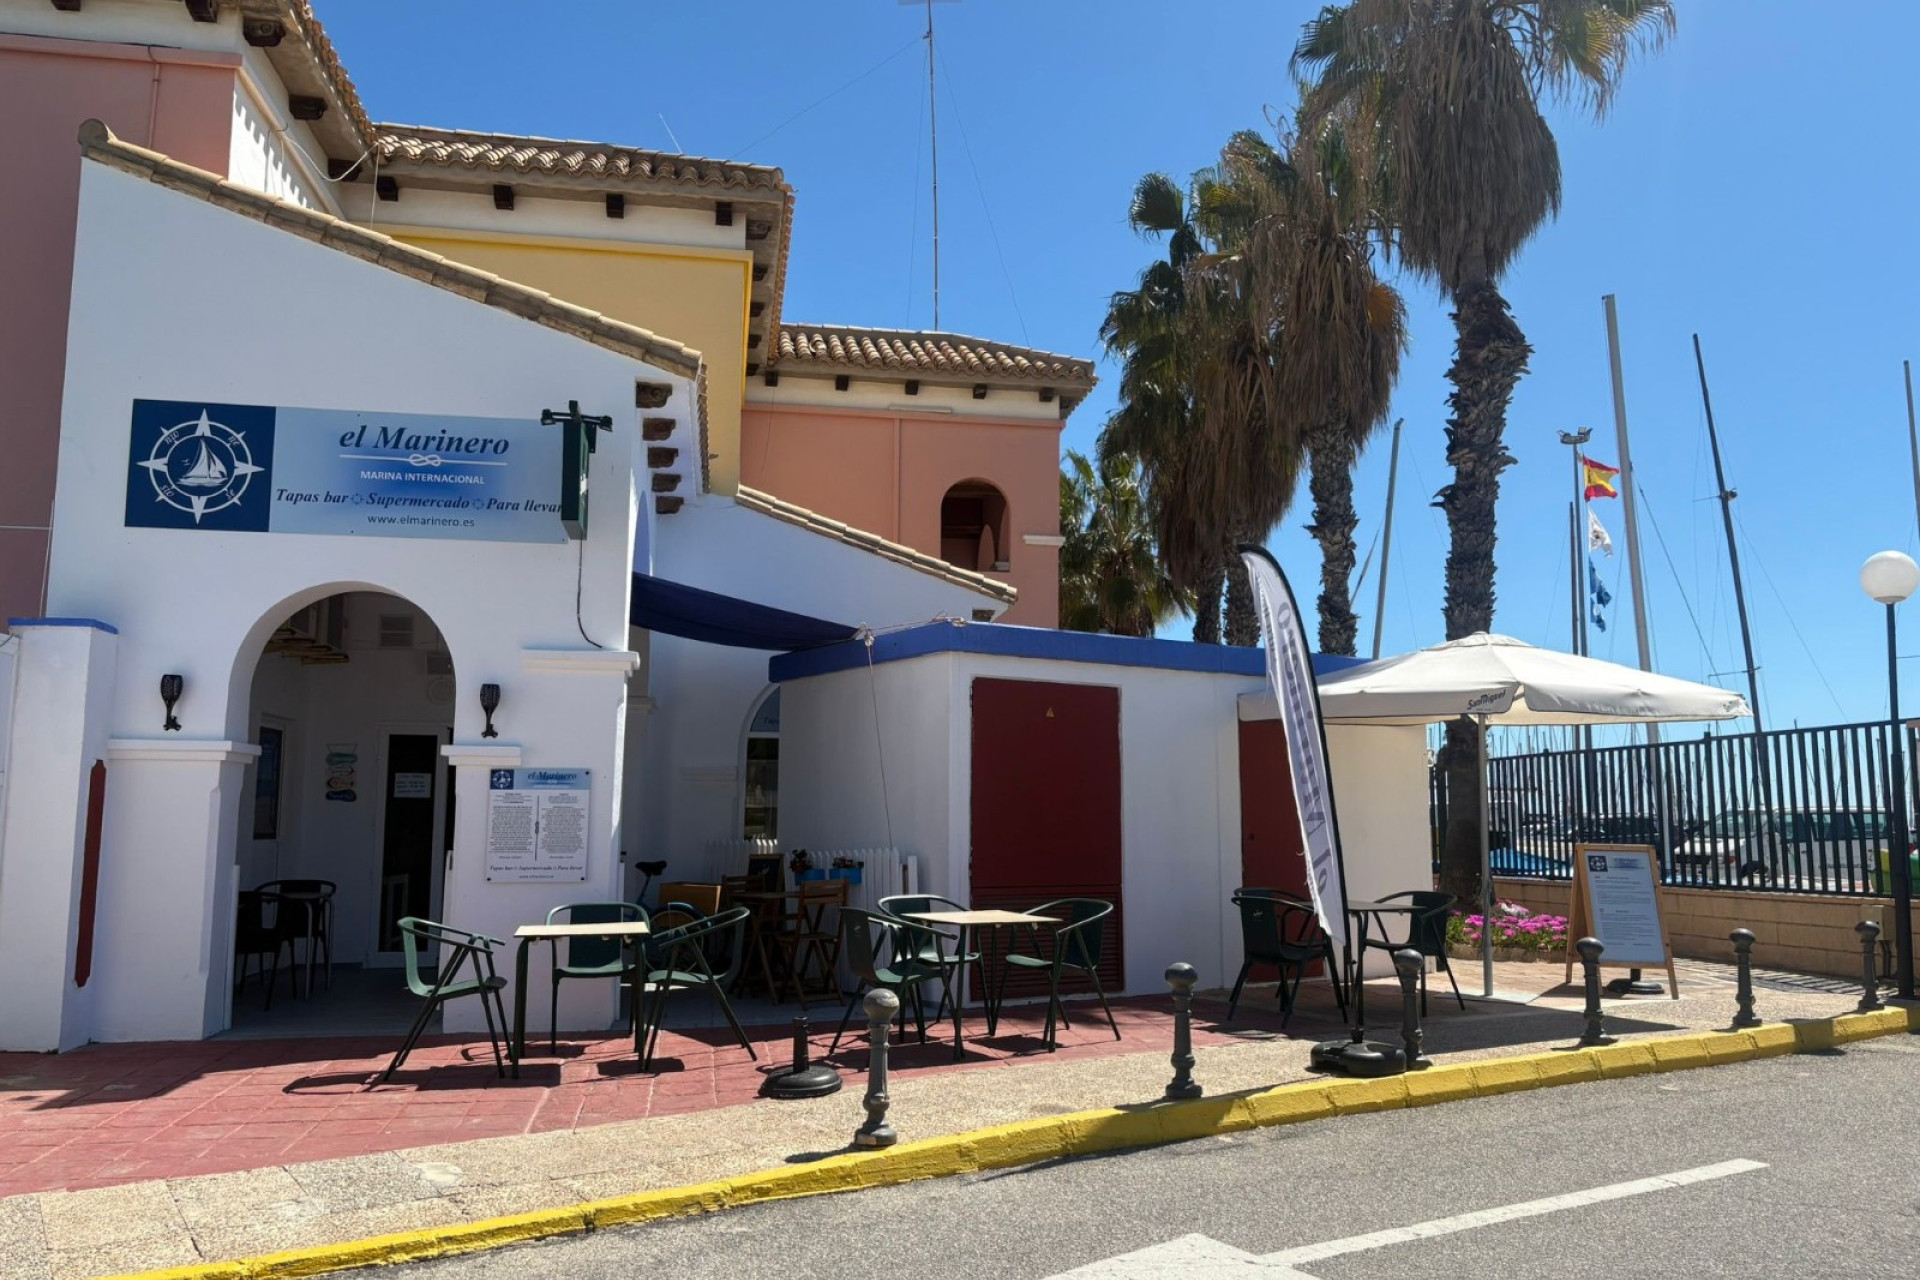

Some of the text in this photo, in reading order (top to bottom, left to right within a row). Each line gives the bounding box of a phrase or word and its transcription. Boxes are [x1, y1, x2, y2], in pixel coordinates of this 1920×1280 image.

[339, 425, 510, 455] el Marinero
[360, 470, 485, 485] MARINA INTERNACIONAL
[276, 488, 319, 504] Tapas
[324, 490, 349, 504] bar
[365, 492, 470, 510] Supermercado
[486, 499, 519, 512] Para
[367, 514, 475, 528] www.elmarinero.es
